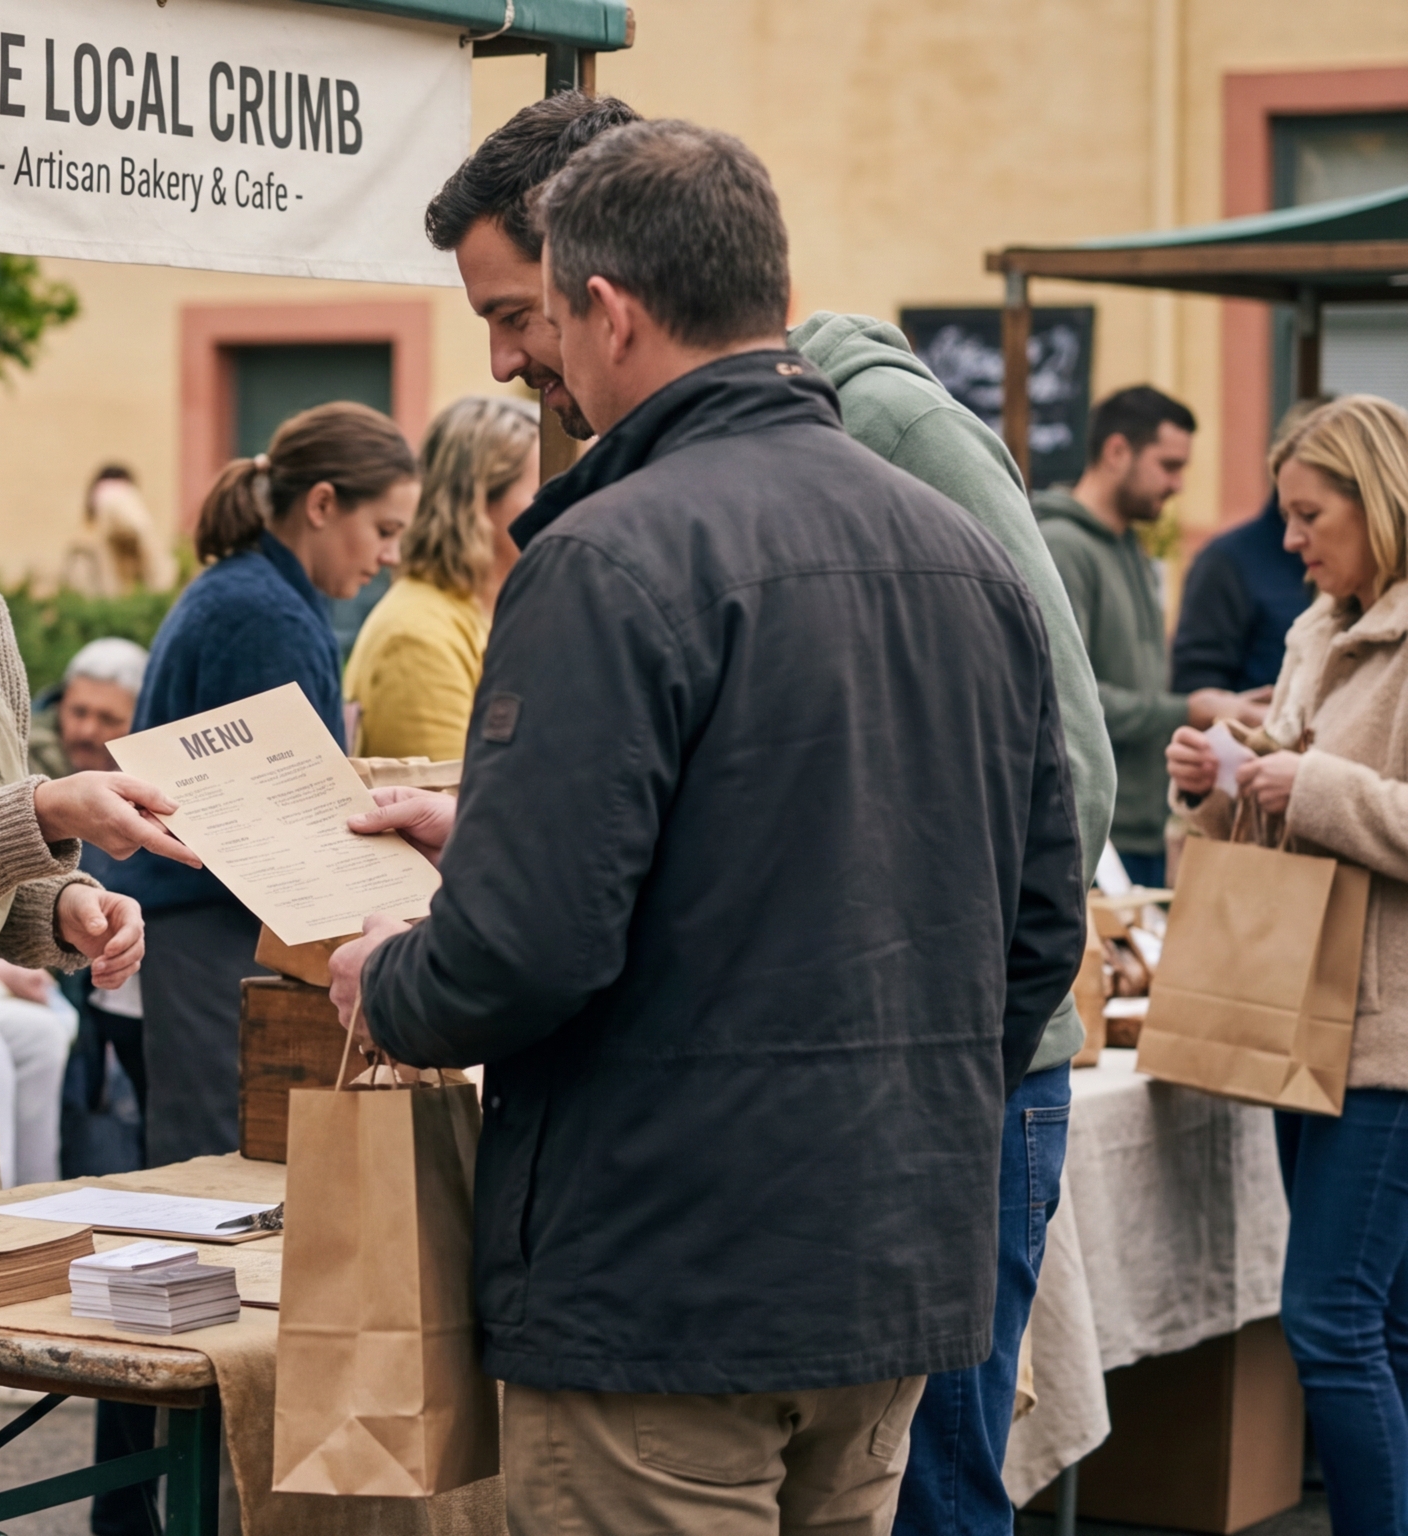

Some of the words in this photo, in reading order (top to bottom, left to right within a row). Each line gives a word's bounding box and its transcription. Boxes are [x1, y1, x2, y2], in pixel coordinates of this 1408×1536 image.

[45, 37, 194, 138] LOCAL
[208, 60, 364, 156] CRUMB
[12, 145, 111, 194] Artisan
[120, 156, 204, 214] Bakery
[210, 166, 227, 207] &
[234, 169, 288, 213] Cafe
[179, 718, 254, 761] MENU
